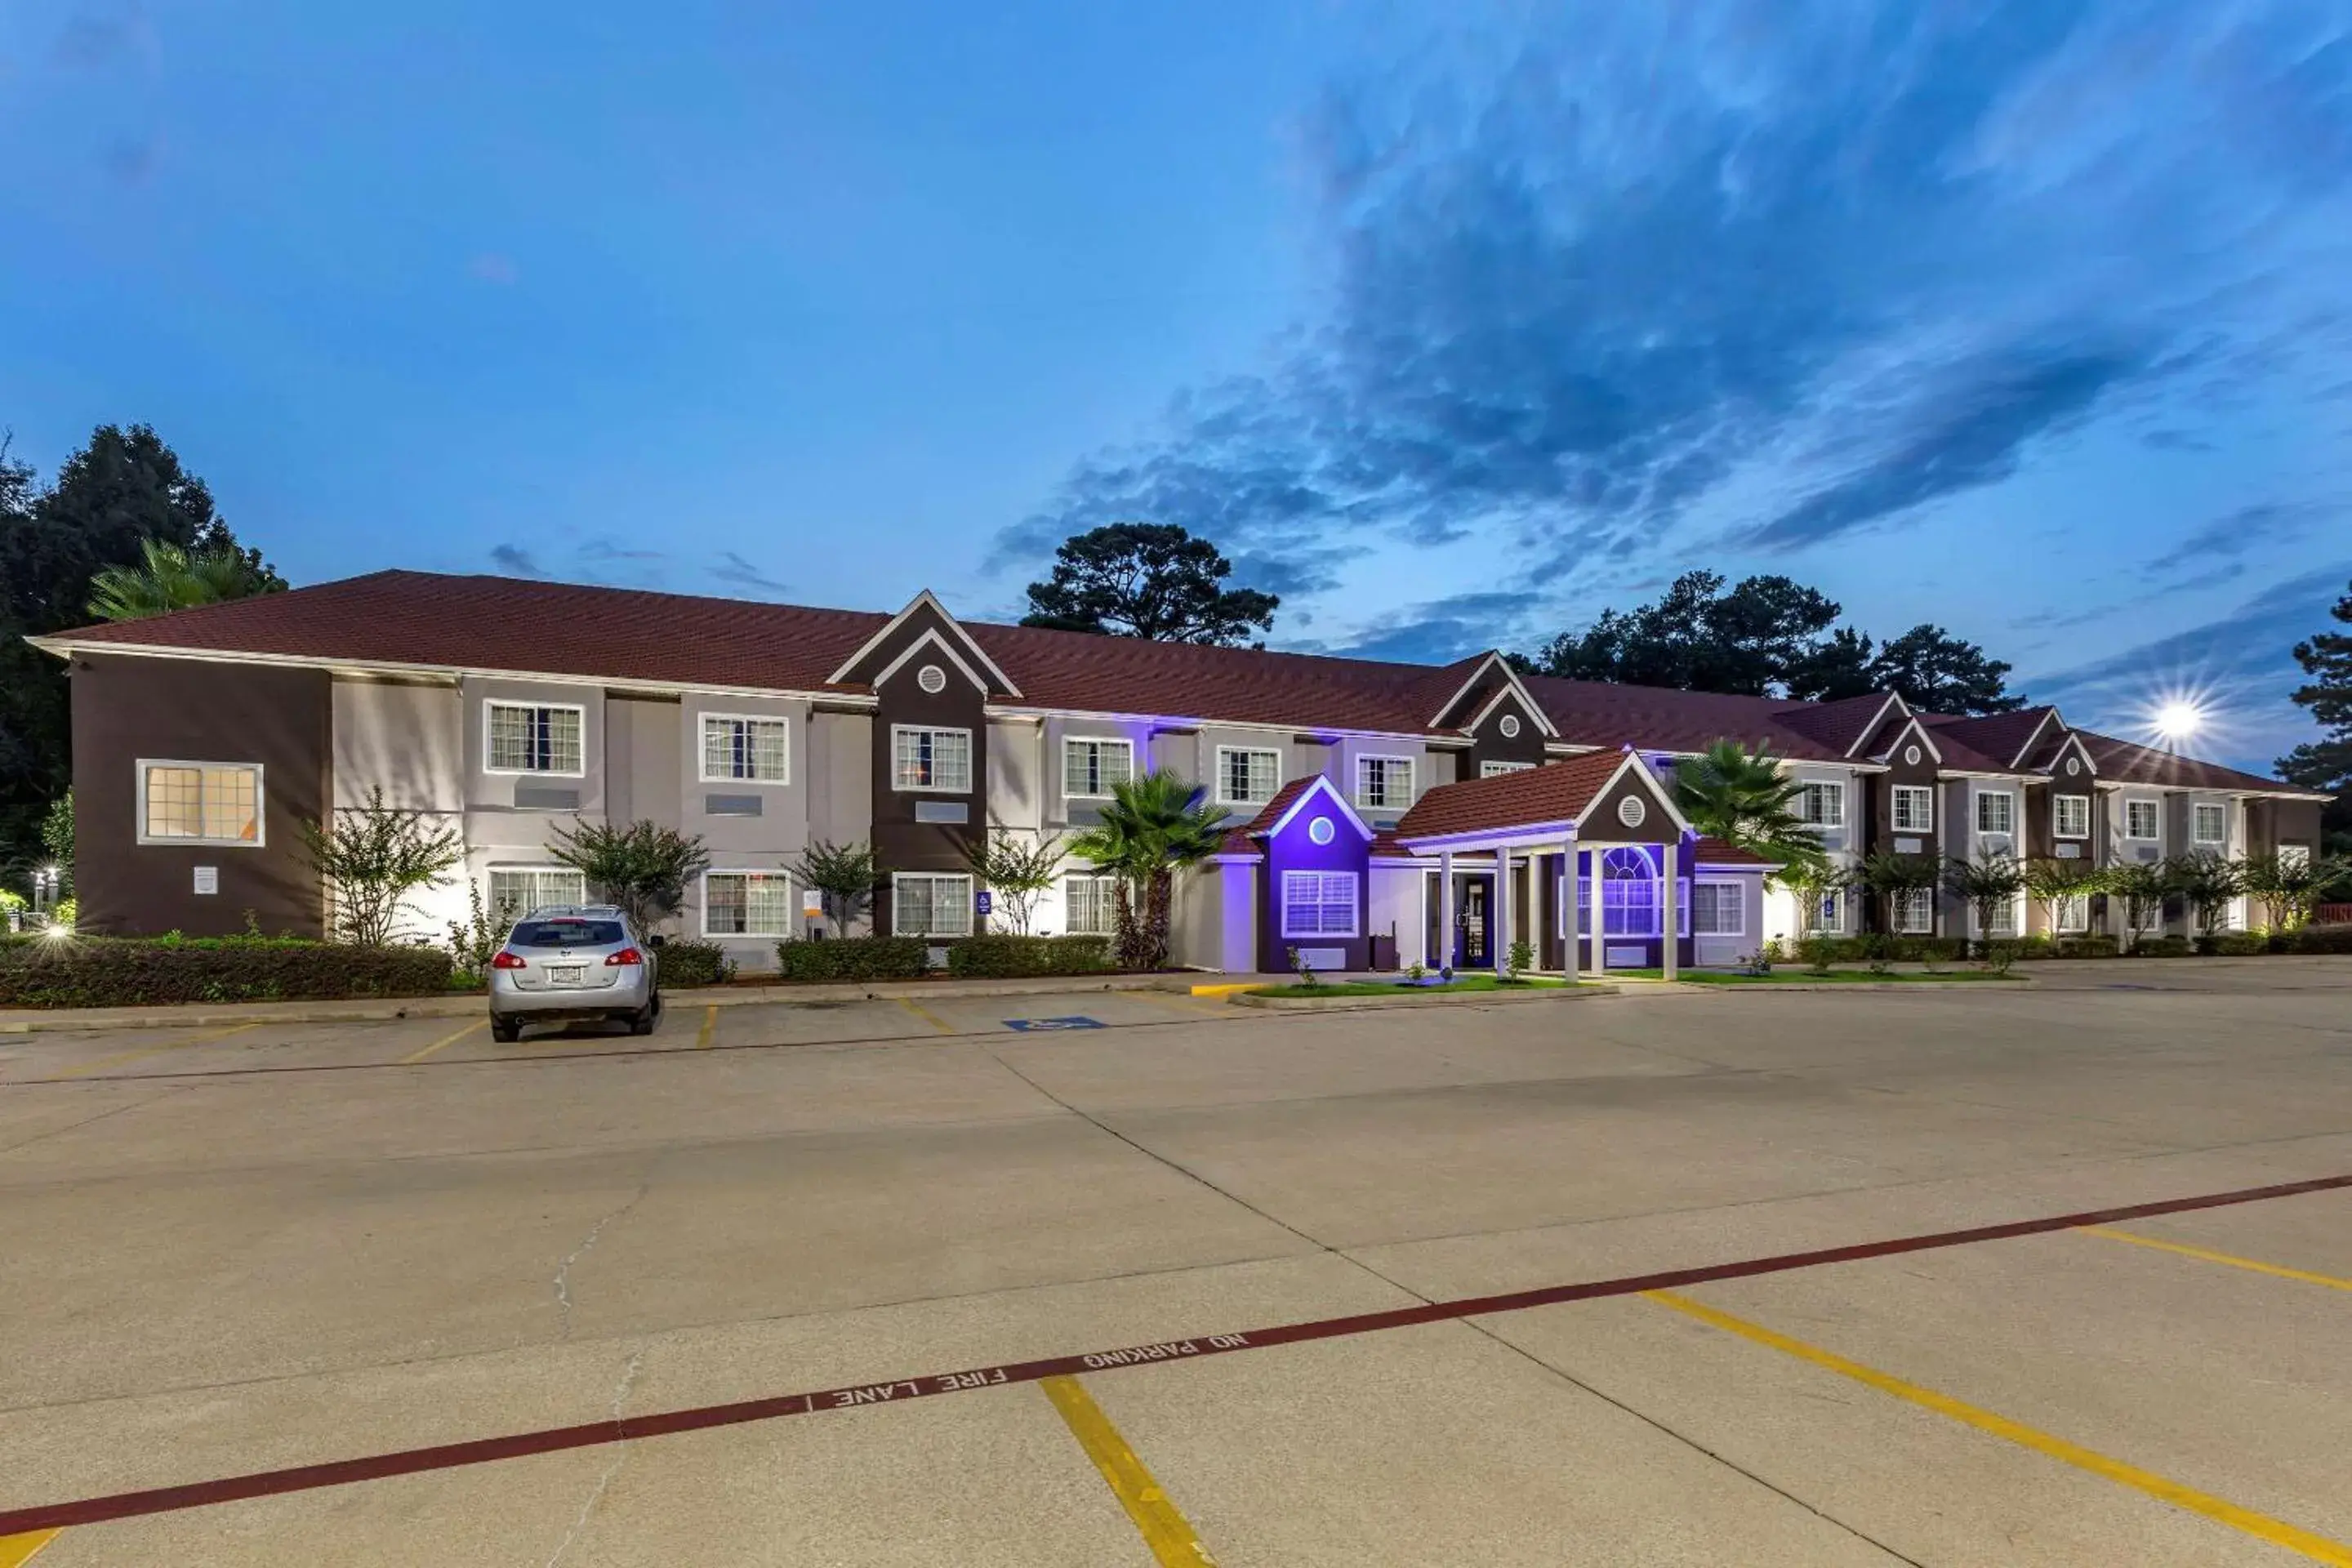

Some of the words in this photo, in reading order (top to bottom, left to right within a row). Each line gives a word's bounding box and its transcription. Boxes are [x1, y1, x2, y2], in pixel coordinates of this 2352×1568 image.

[1208, 1333, 1250, 1348] NO
[1083, 1341, 1200, 1369] PARKING
[937, 1369, 1008, 1391] FIRE
[832, 1381, 920, 1407] LANE
